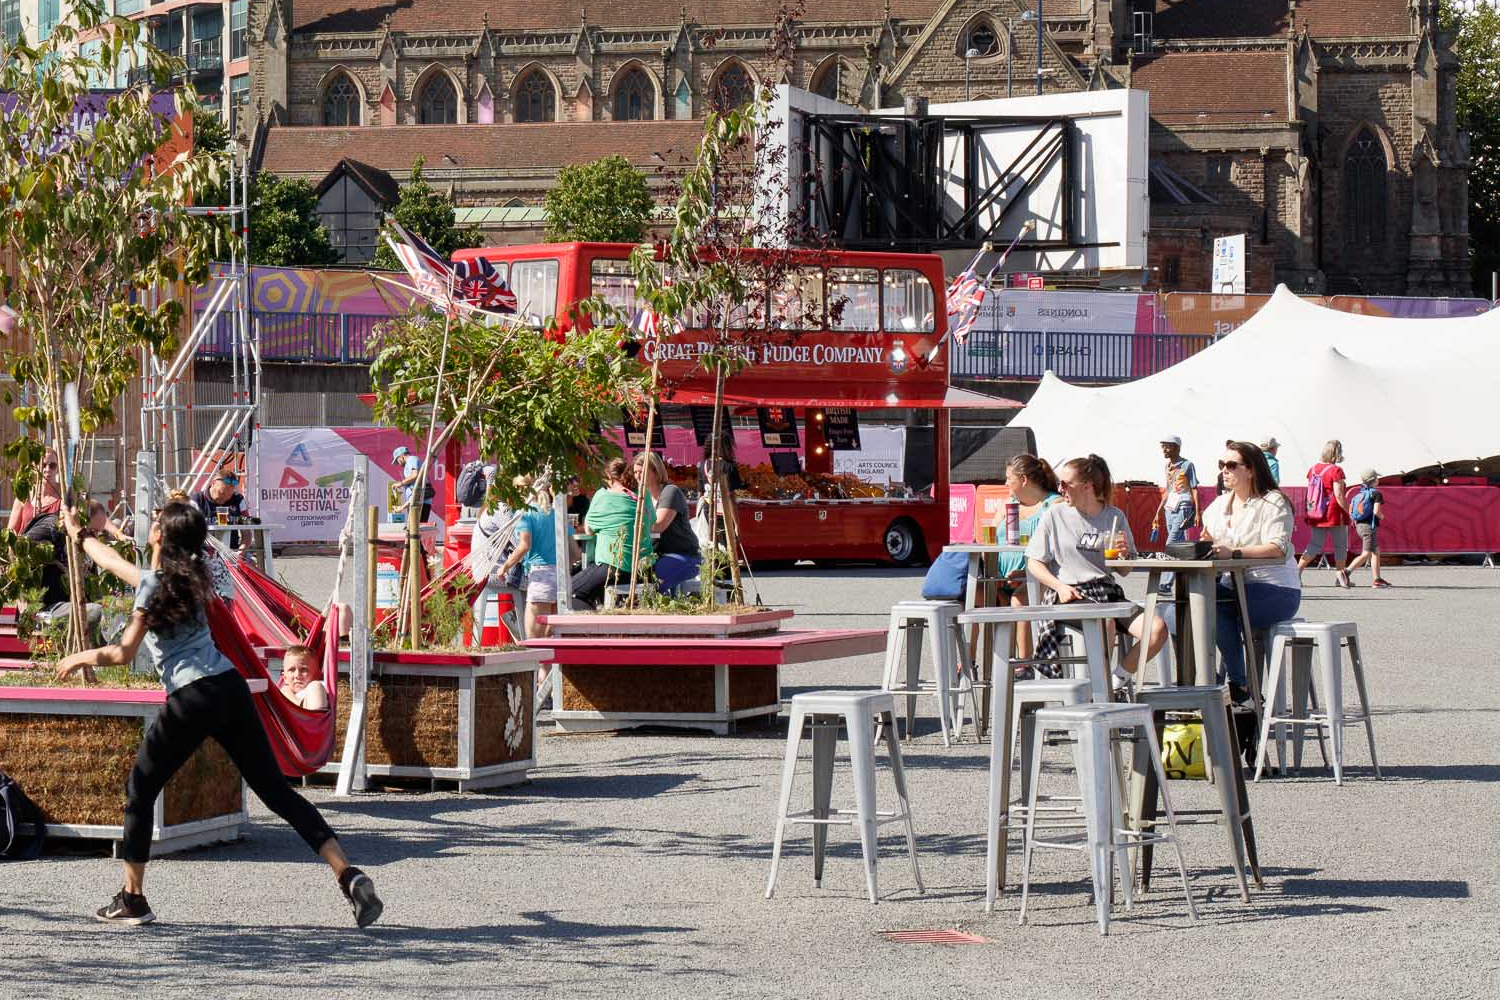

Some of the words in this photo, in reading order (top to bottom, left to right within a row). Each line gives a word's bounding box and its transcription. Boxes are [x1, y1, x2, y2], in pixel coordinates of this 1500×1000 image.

[762, 342, 811, 364] FUDGE
[813, 343, 884, 366] COMPANY
[261, 488, 333, 500] BIRMINGHAM
[336, 488, 354, 499] 20
[289, 500, 339, 512] FESTIVAL
[286, 513, 339, 521] commonwealth
